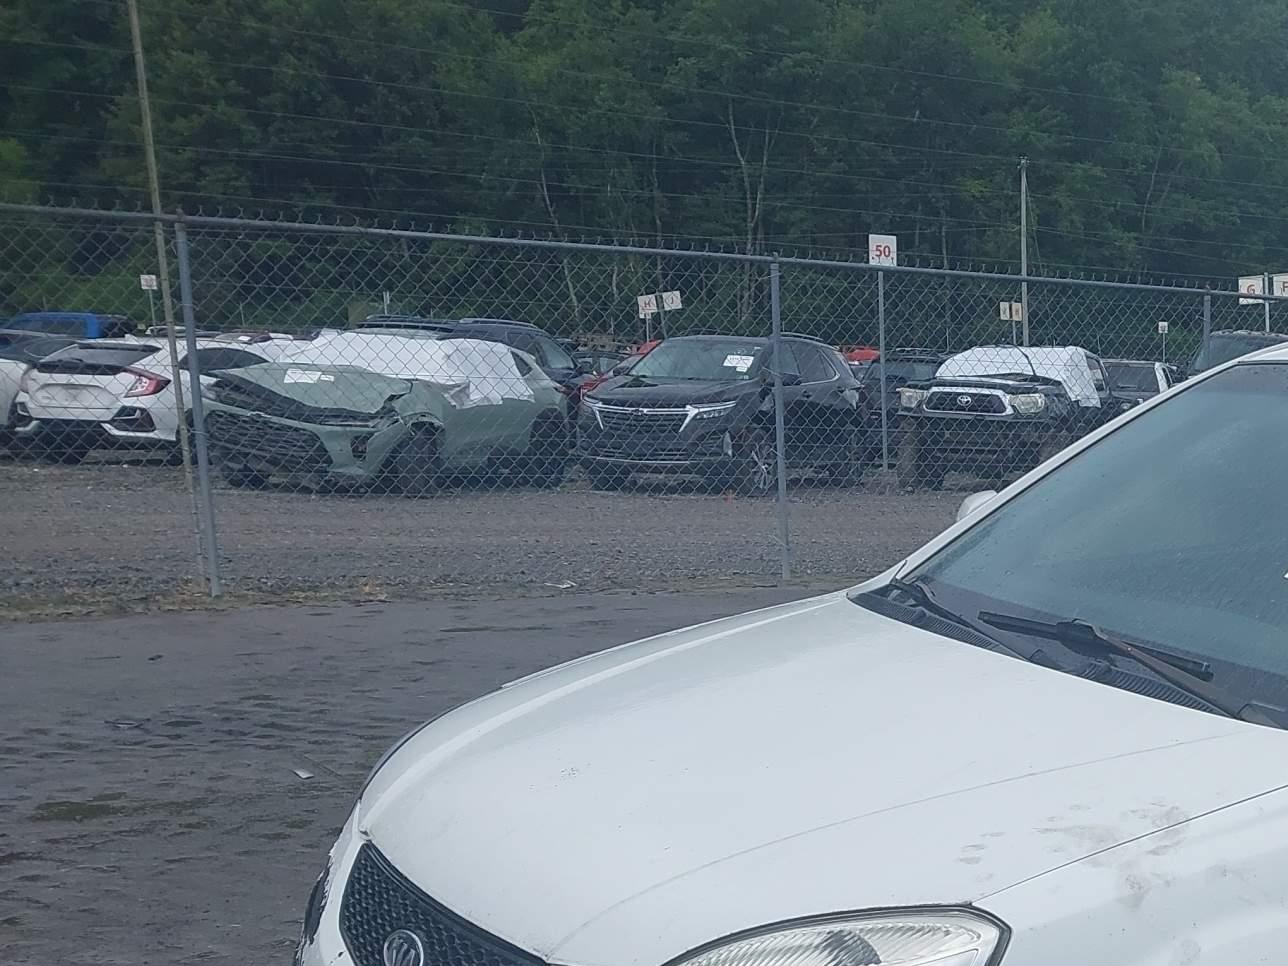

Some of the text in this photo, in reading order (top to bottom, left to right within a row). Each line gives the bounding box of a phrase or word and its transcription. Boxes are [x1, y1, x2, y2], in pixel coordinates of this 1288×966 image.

[875, 244, 891, 257] 50
[1247, 284, 1256, 295] G
[1282, 281, 1288, 292] F
